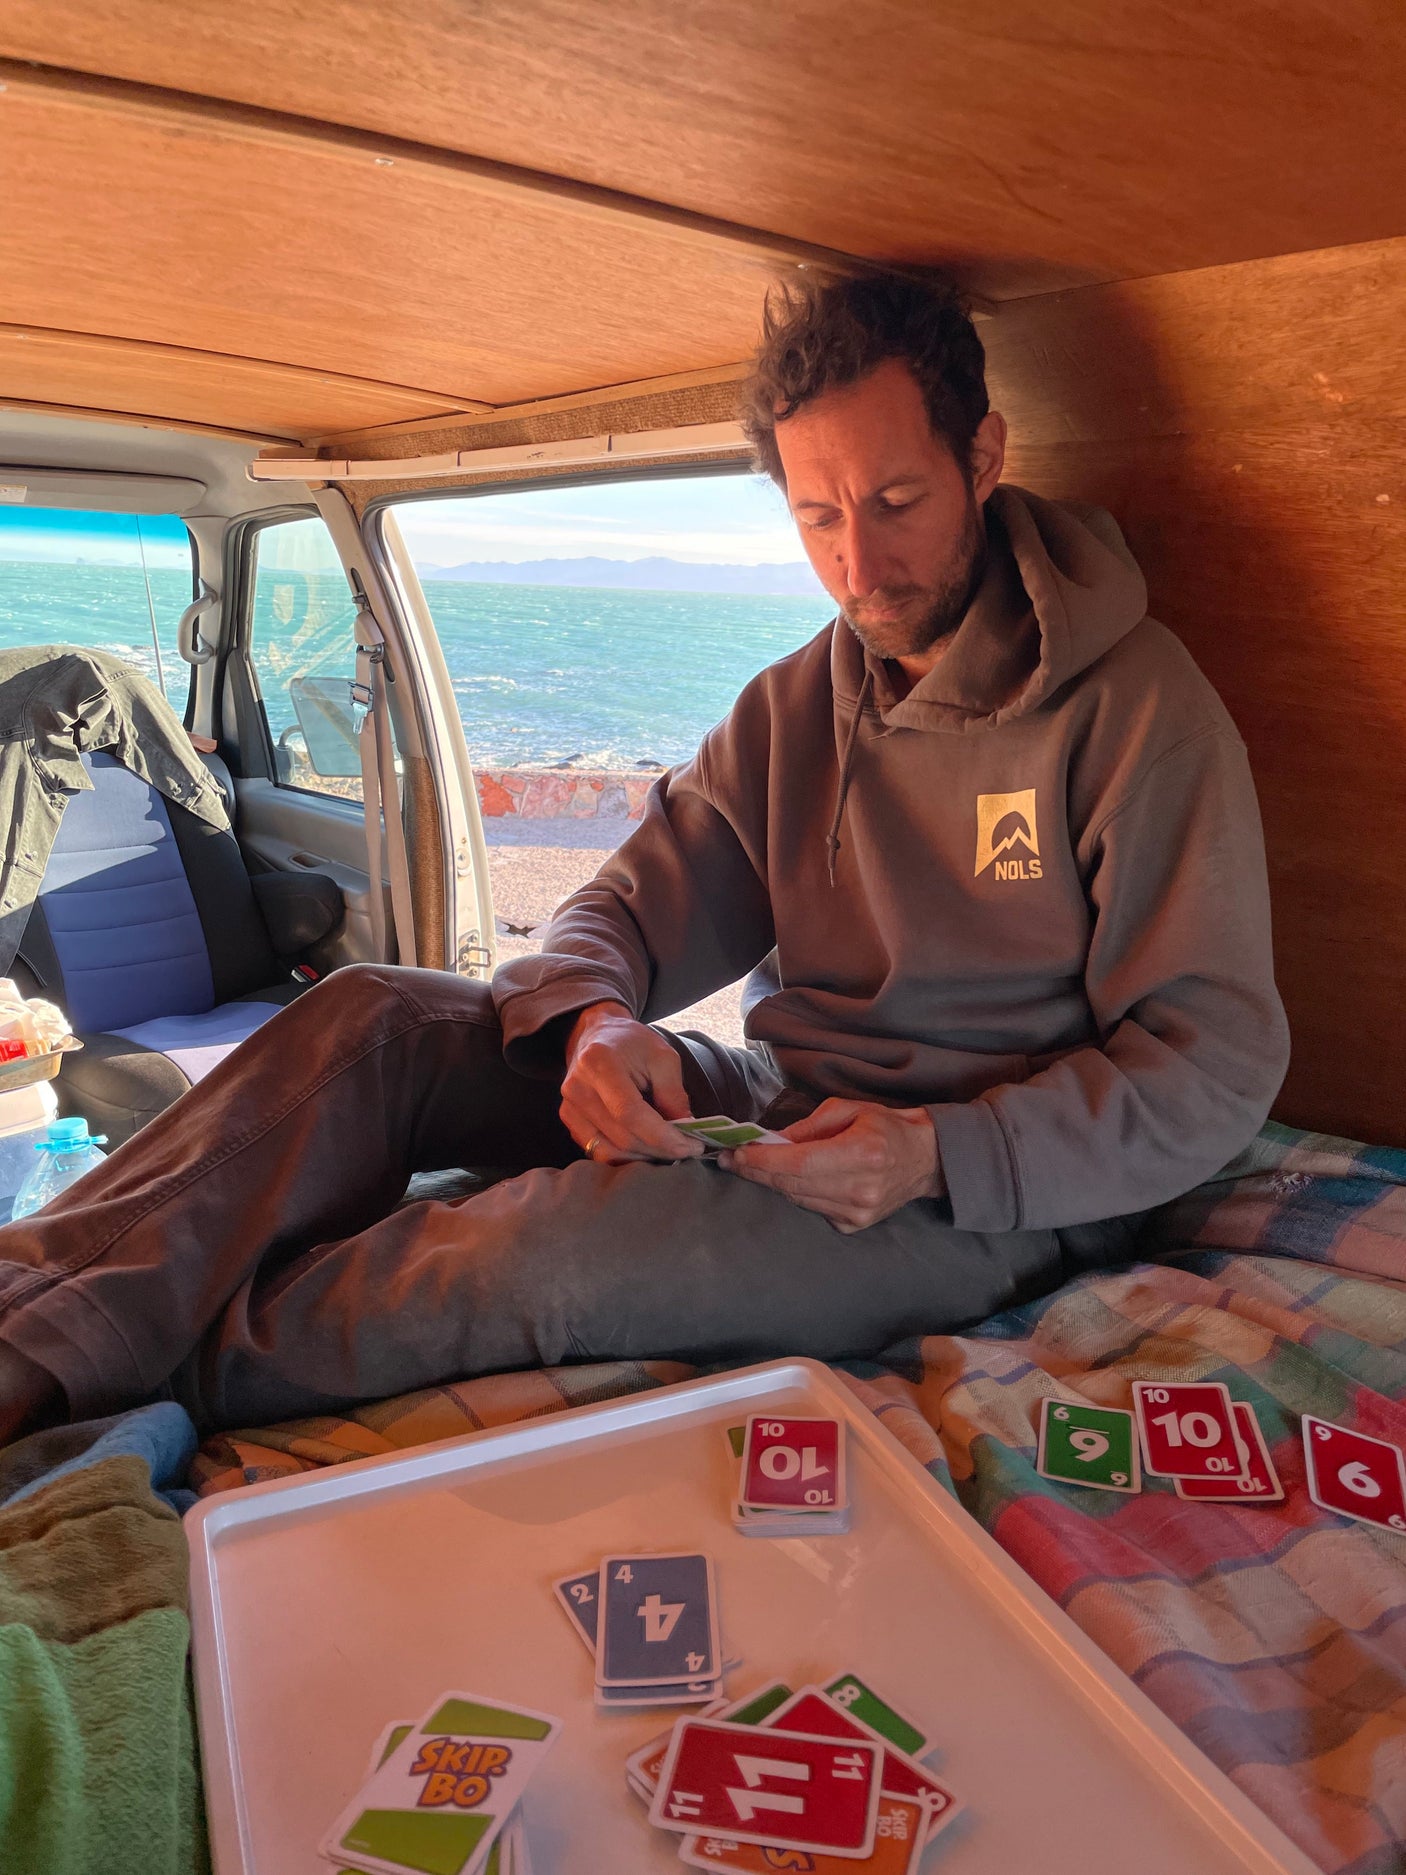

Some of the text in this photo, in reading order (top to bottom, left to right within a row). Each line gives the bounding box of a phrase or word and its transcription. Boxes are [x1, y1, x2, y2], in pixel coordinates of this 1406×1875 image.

[995, 859, 1043, 880] NOLS
[1142, 1389, 1170, 1404] 10
[758, 1423, 785, 1437] 10
[1152, 1411, 1221, 1448] 10
[759, 1445, 830, 1481] 10
[1205, 1457, 1235, 1472] 10
[1237, 1477, 1267, 1493] 10
[804, 1489, 833, 1504] 10
[614, 1564, 634, 1584] 4
[570, 1583, 594, 1605] 2
[637, 1594, 686, 1642] 4
[685, 1651, 705, 1672] 4
[831, 1684, 860, 1707] 8
[832, 1753, 865, 1780] 11
[416, 1771, 492, 1808] BO
[726, 1753, 809, 1821] 11
[669, 1790, 703, 1818] 11
[877, 1815, 892, 1838] BO
